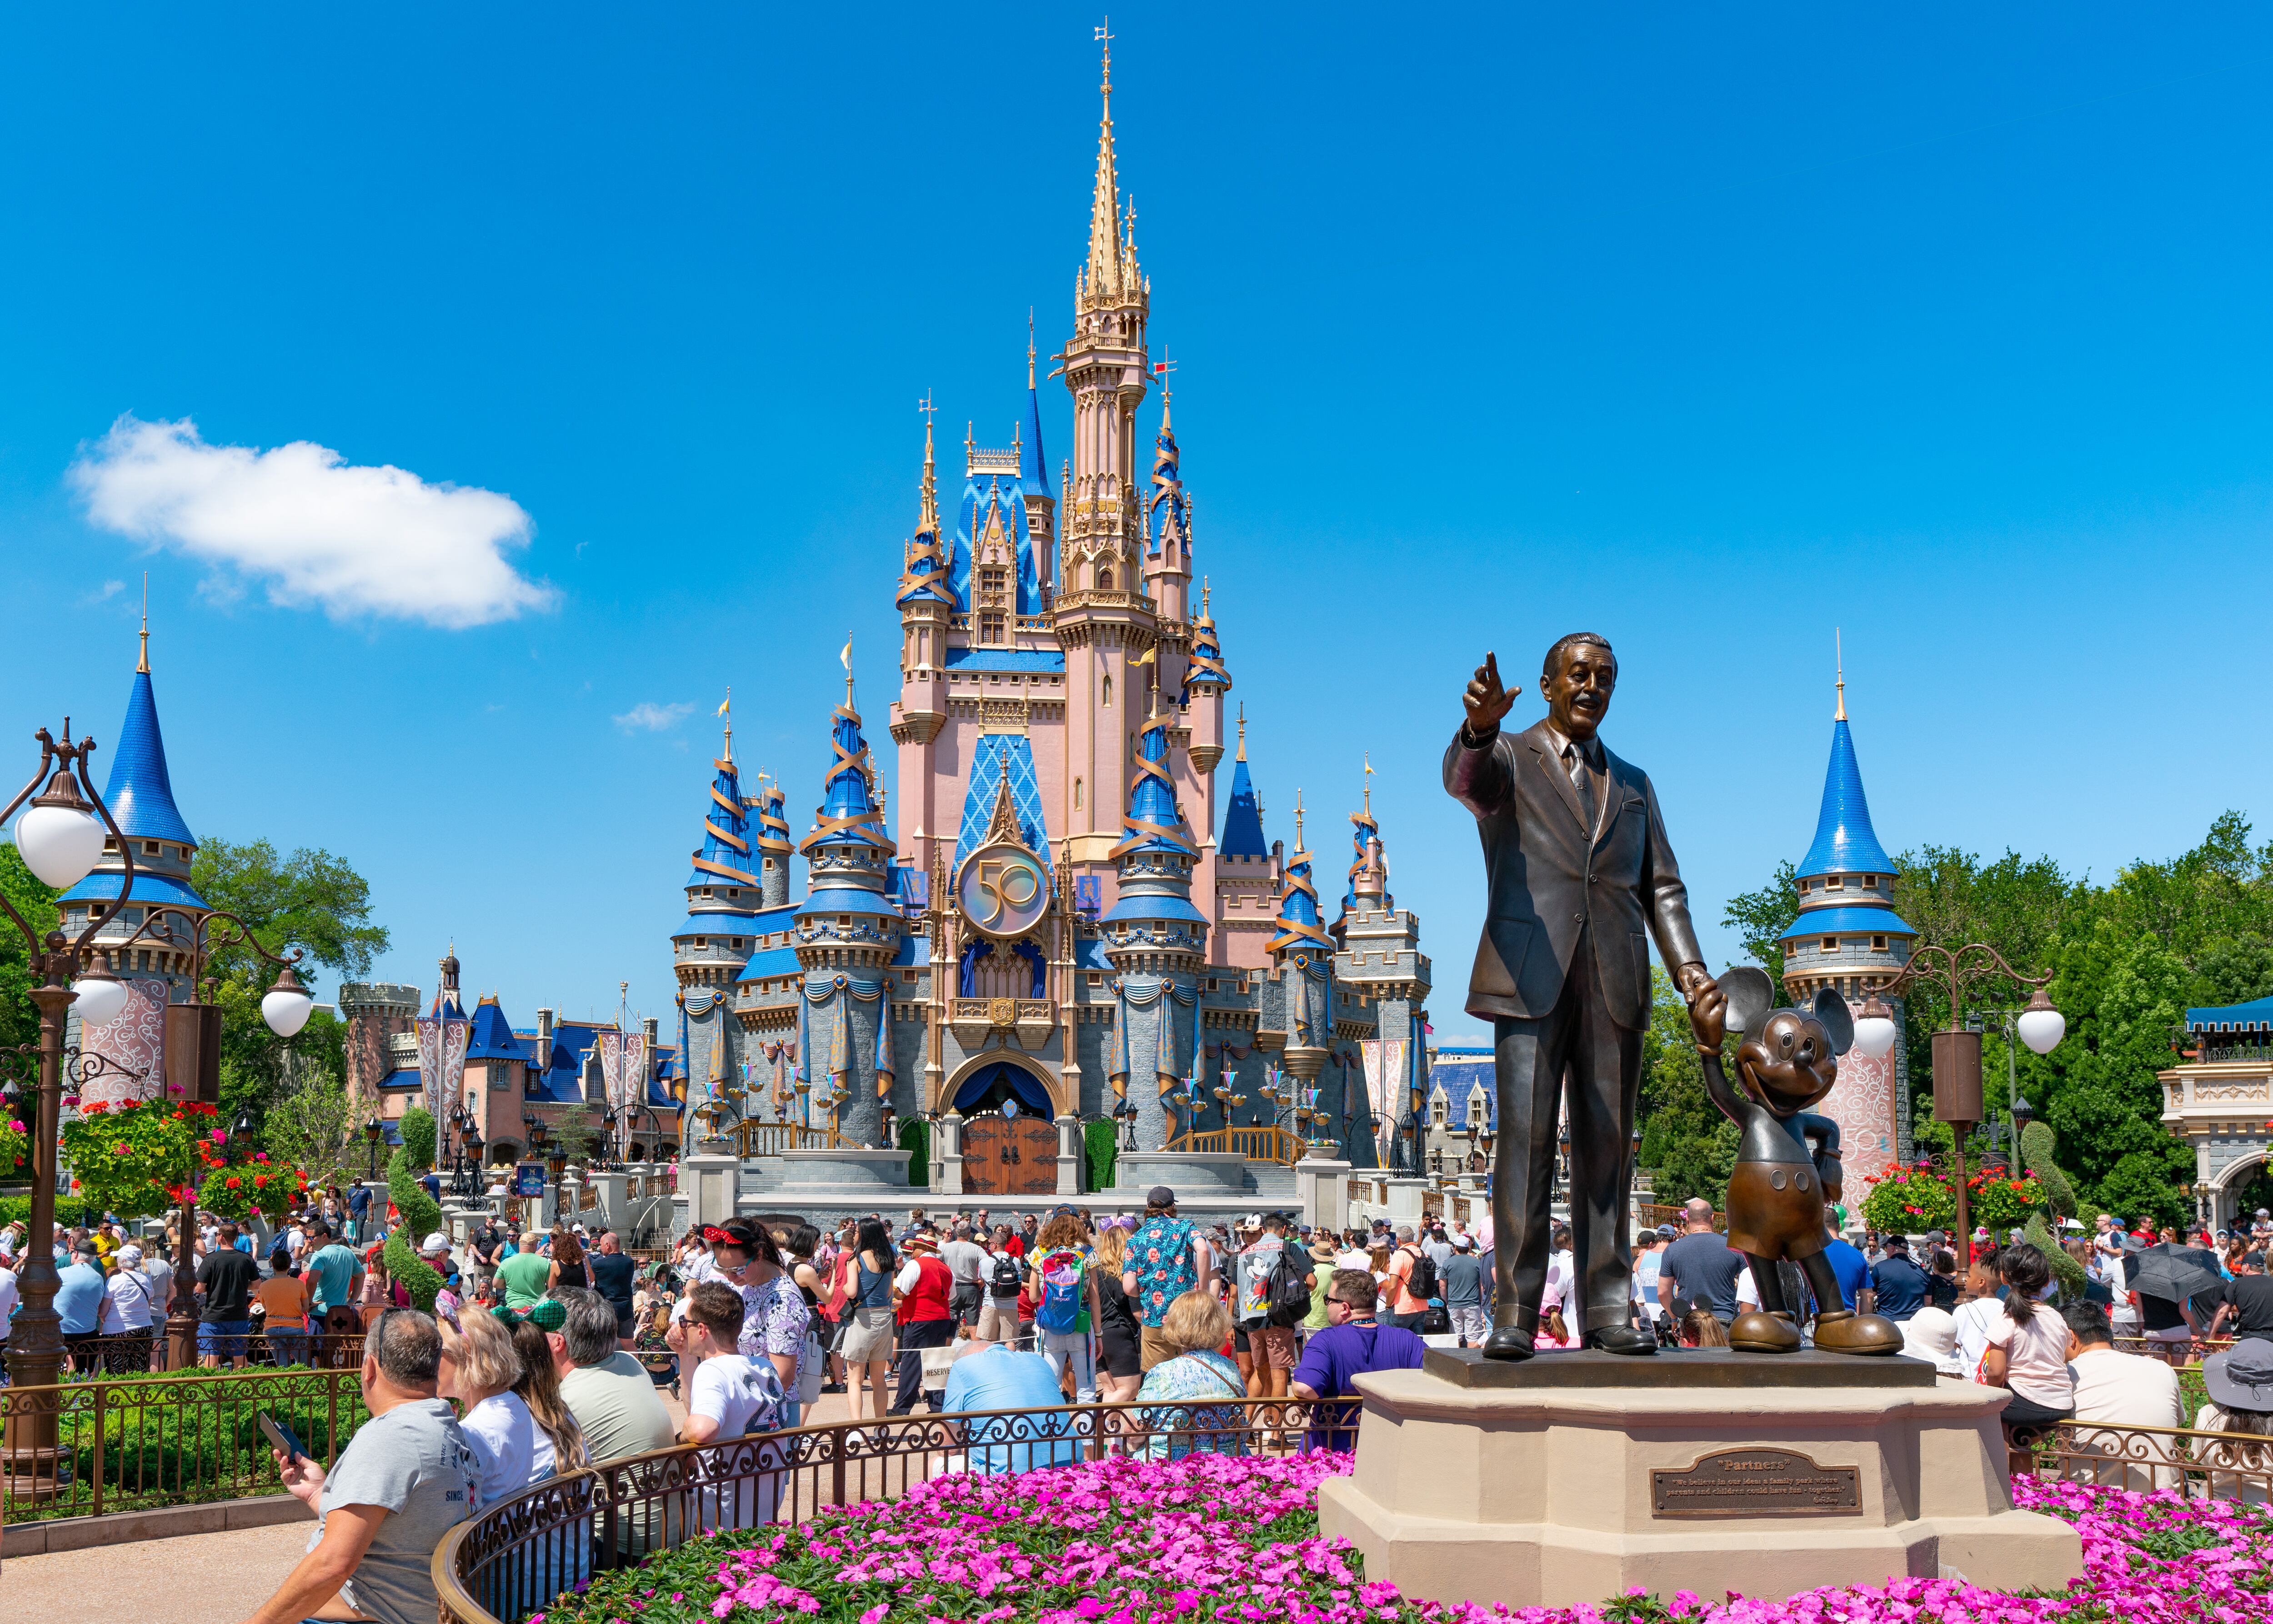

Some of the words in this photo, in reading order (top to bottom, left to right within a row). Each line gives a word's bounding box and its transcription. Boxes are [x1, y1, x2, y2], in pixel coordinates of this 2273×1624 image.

[979, 860, 1038, 924] 50
[1844, 1128, 1877, 1161] 50
[926, 1367, 952, 1377] RESERVE
[1769, 1478, 1794, 1486] family
[1796, 1478, 1813, 1486] park
[446, 1490, 464, 1501] SINCE
[1666, 1489, 1695, 1497] parents
